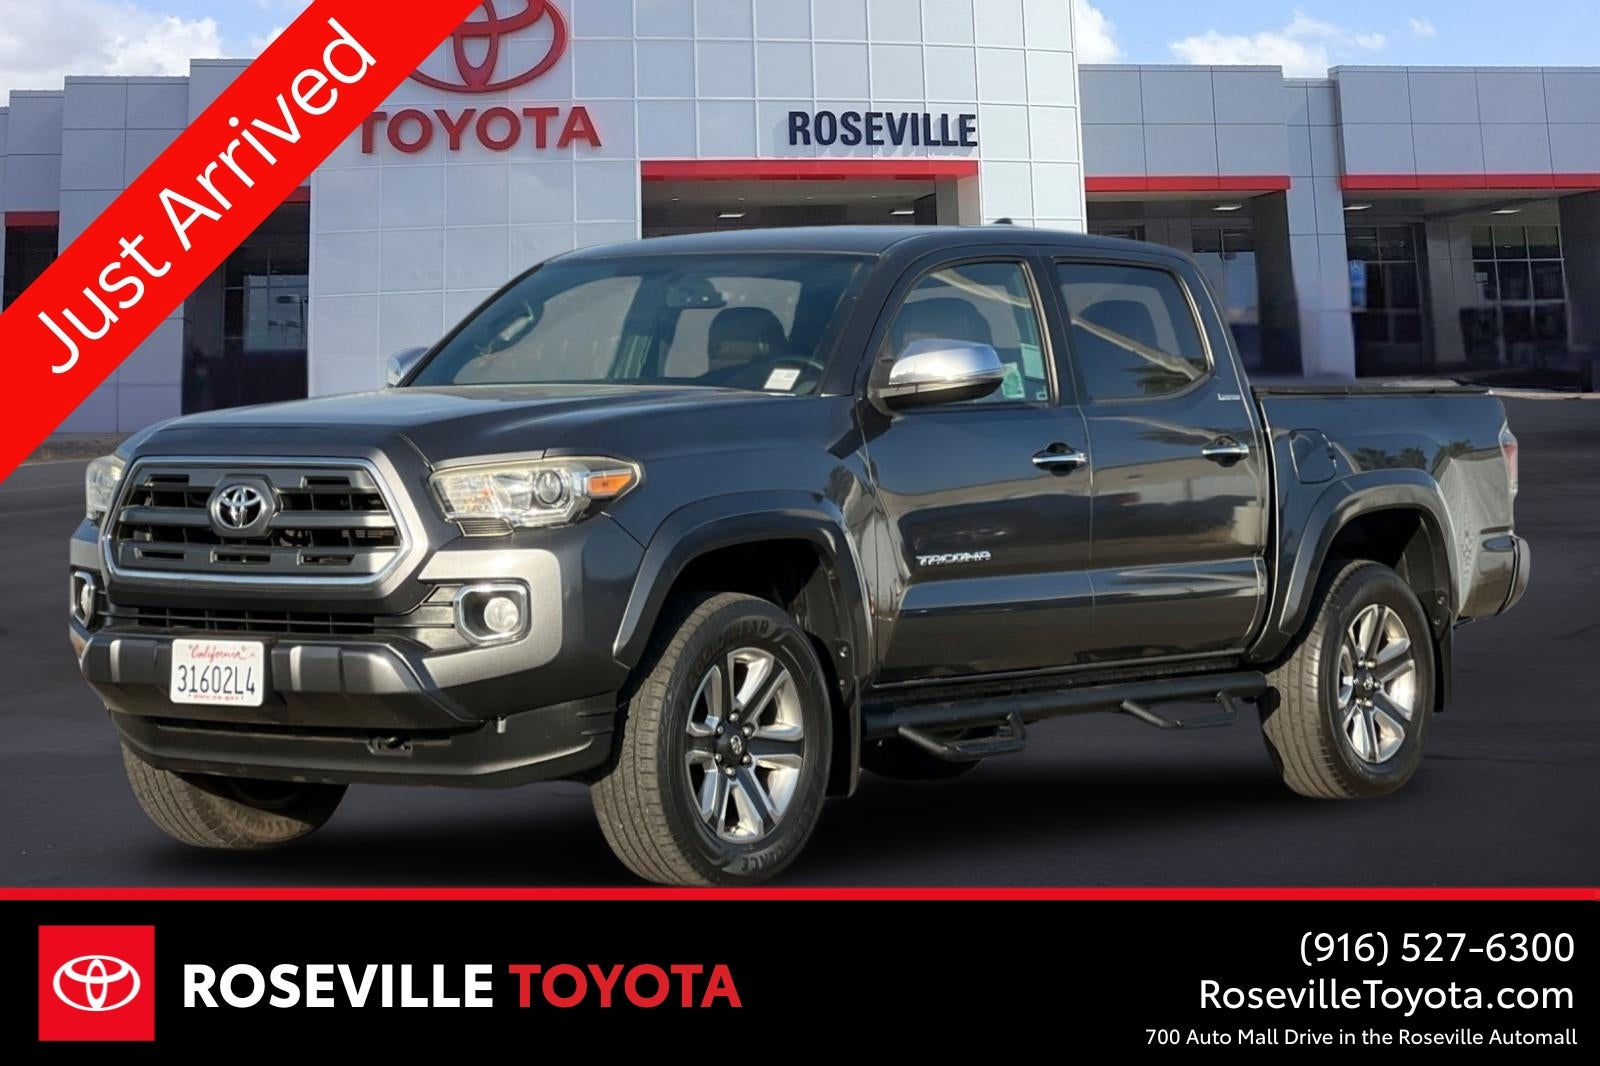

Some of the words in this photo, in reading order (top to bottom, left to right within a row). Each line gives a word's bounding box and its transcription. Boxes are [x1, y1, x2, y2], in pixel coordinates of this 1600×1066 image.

[361, 106, 602, 153] TOYOTA
[788, 111, 978, 146] ROSEVILLE
[190, 644, 246, 663] California
[177, 665, 255, 694] 31602L4
